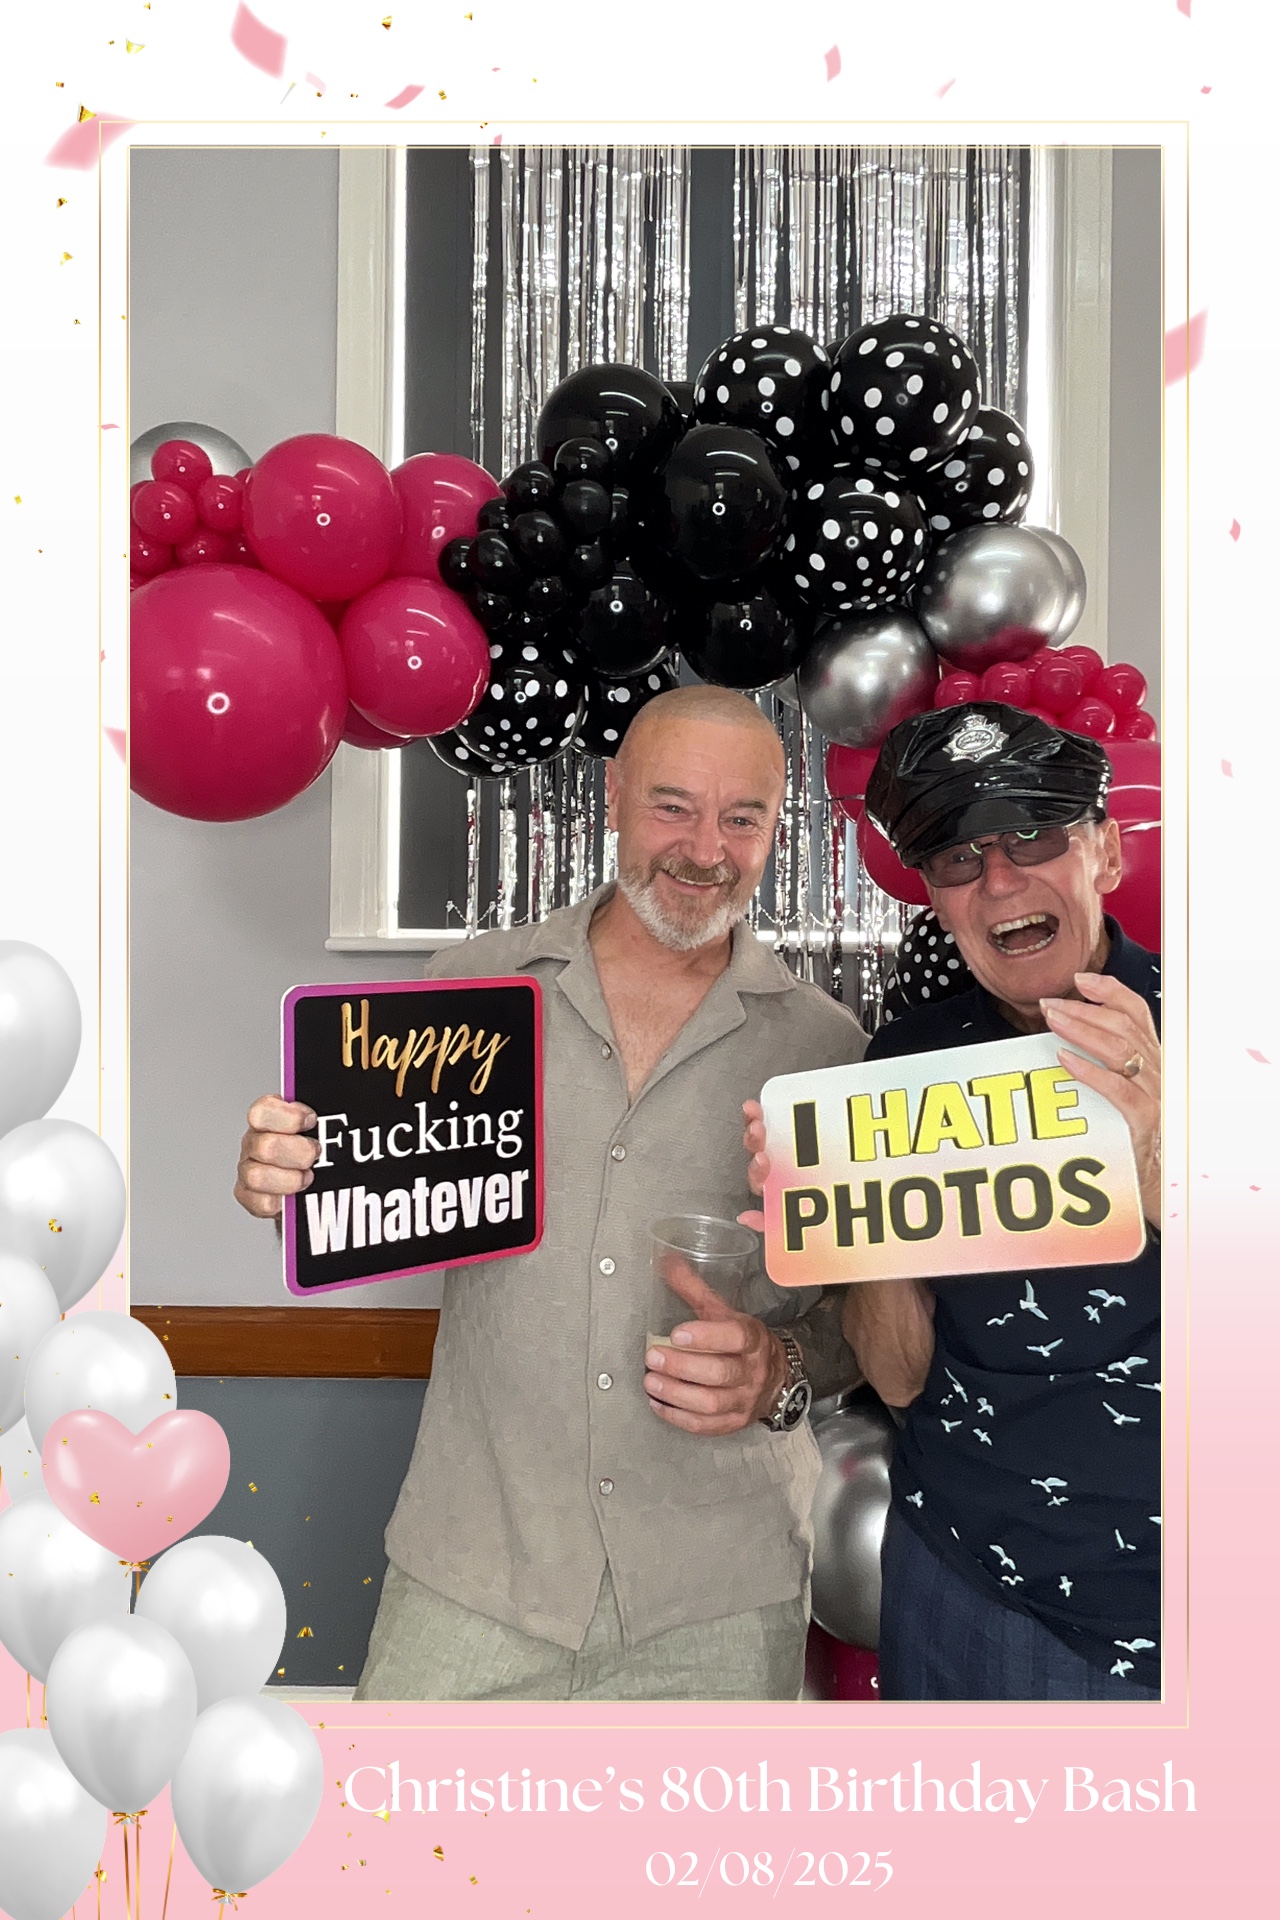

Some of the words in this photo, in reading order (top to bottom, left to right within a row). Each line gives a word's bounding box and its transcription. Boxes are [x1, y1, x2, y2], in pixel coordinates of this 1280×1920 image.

[341, 998, 511, 1098] Happy
[312, 1100, 524, 1169] Fucking
[793, 1101, 820, 1168] I
[846, 1066, 1088, 1162] HATE
[305, 1168, 530, 1256] Whatever
[783, 1156, 1112, 1252] PHOTOS
